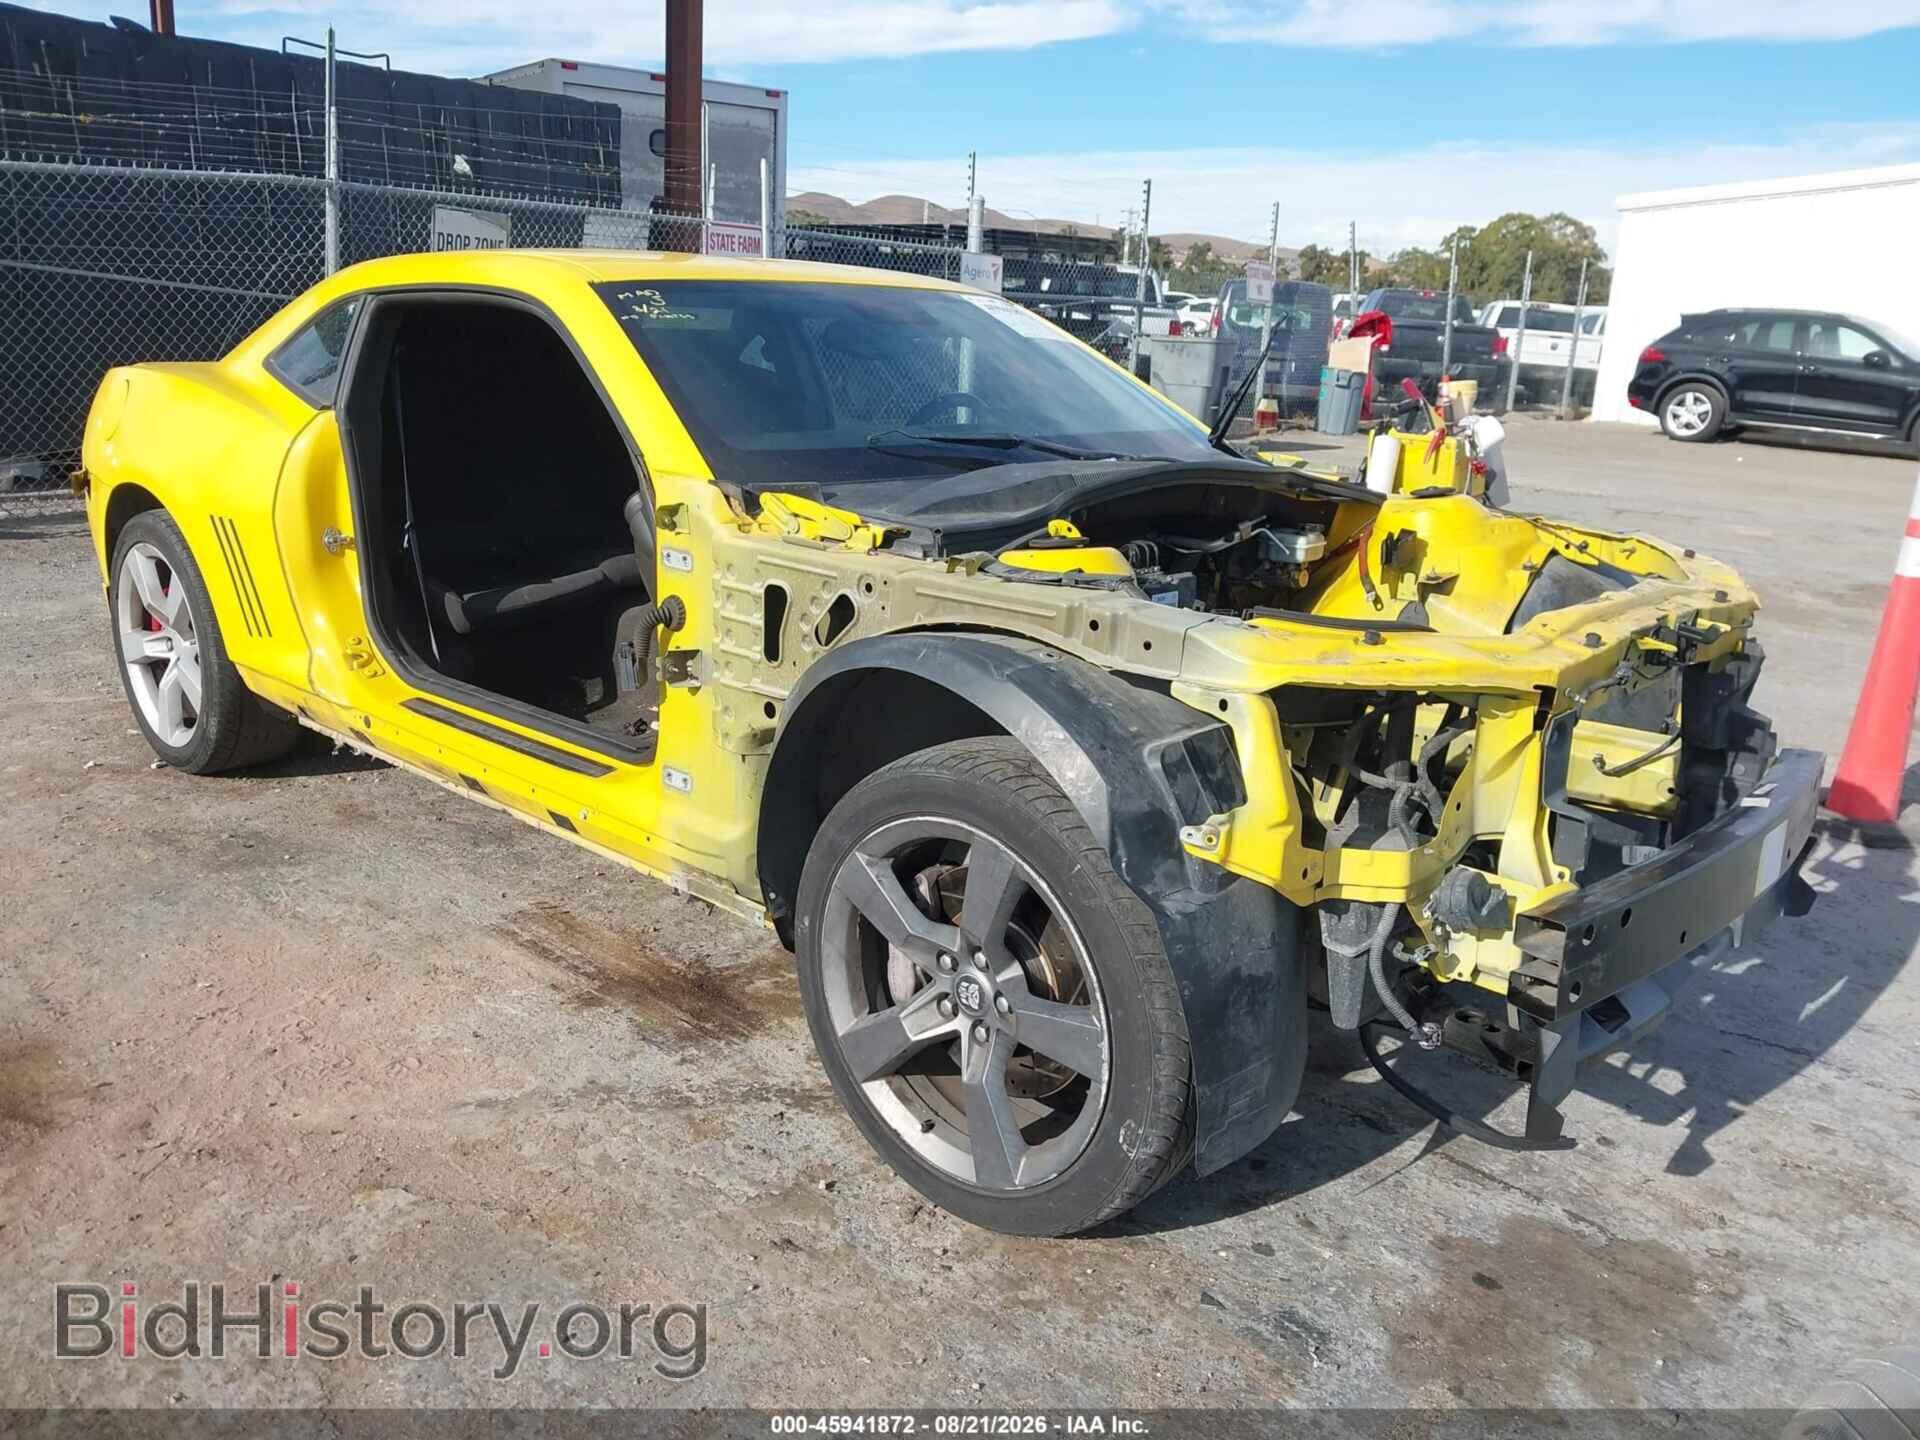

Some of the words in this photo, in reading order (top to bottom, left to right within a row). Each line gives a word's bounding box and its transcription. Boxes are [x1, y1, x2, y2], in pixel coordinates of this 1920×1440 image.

[438, 232, 471, 251] DROP
[710, 232, 736, 252] STATE
[738, 235, 761, 254] FARM
